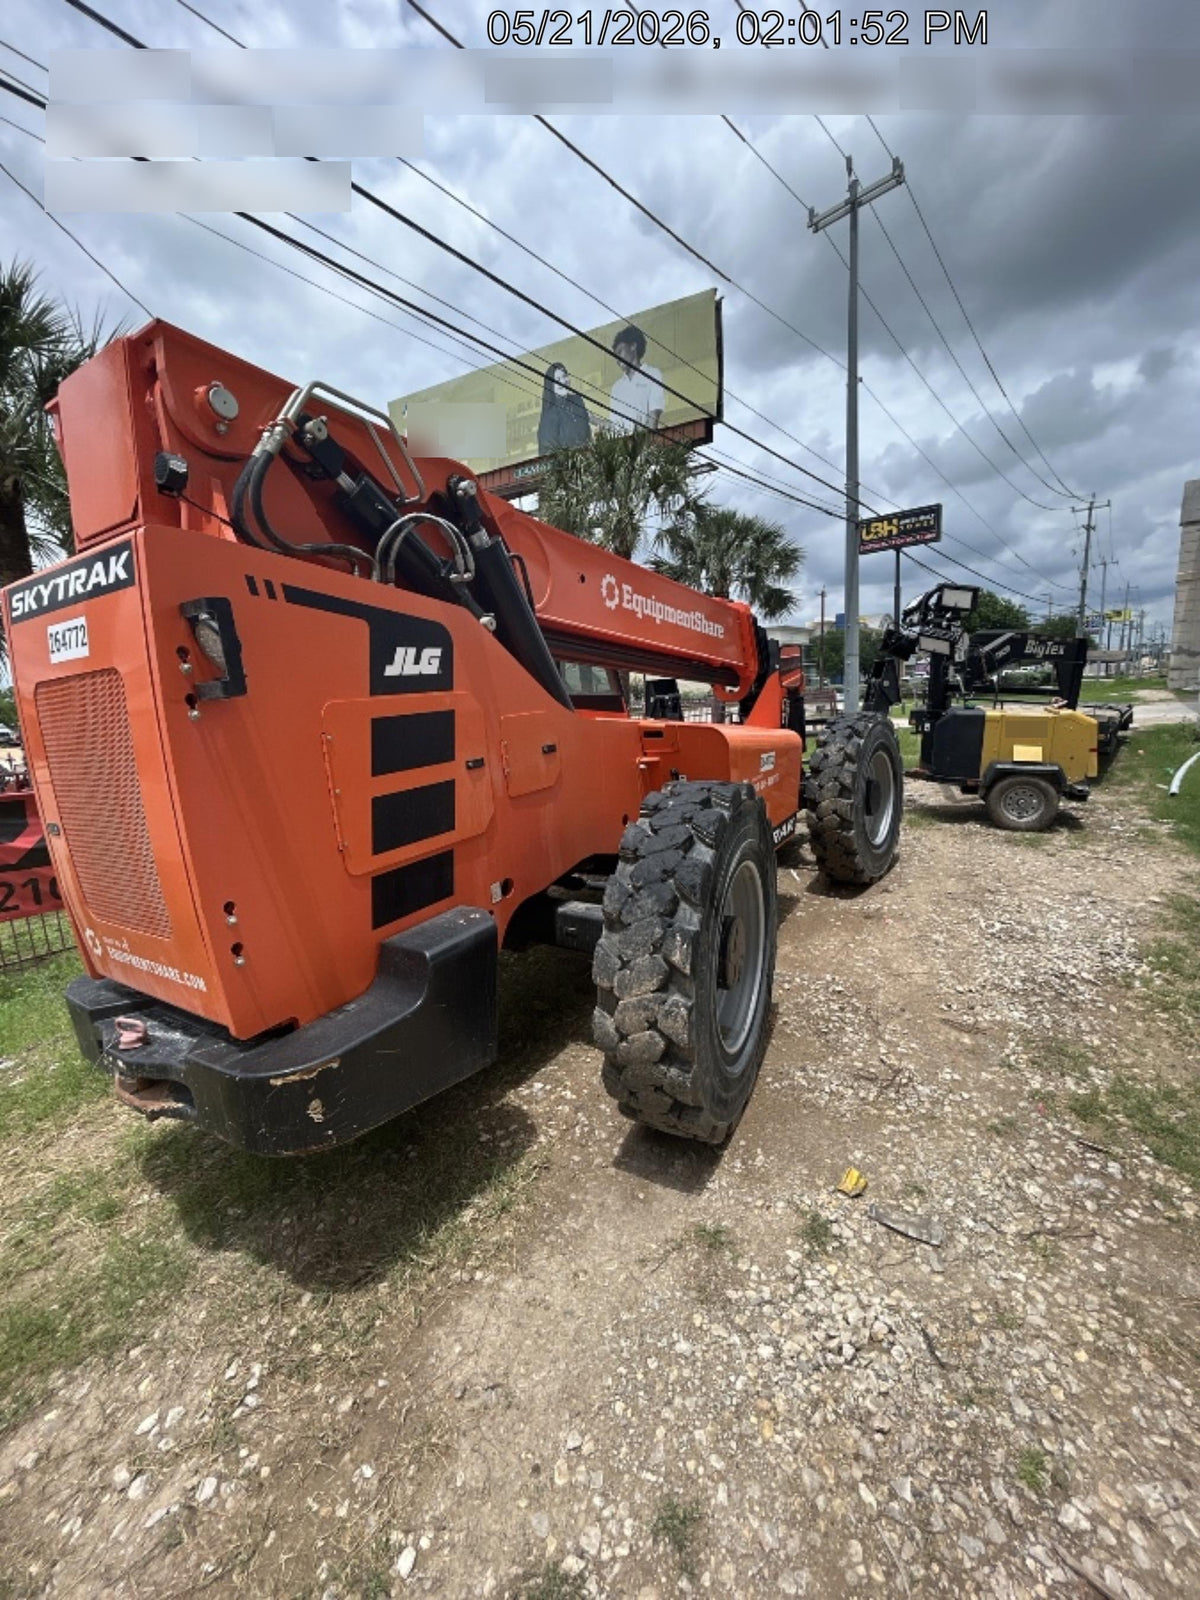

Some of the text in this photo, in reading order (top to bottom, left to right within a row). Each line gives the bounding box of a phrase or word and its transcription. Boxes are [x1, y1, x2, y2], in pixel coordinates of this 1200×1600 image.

[12, 550, 130, 618] SKYTRAK
[622, 583, 724, 639] EquipmentShare
[49, 624, 87, 654] 264772
[384, 646, 442, 676] JLG
